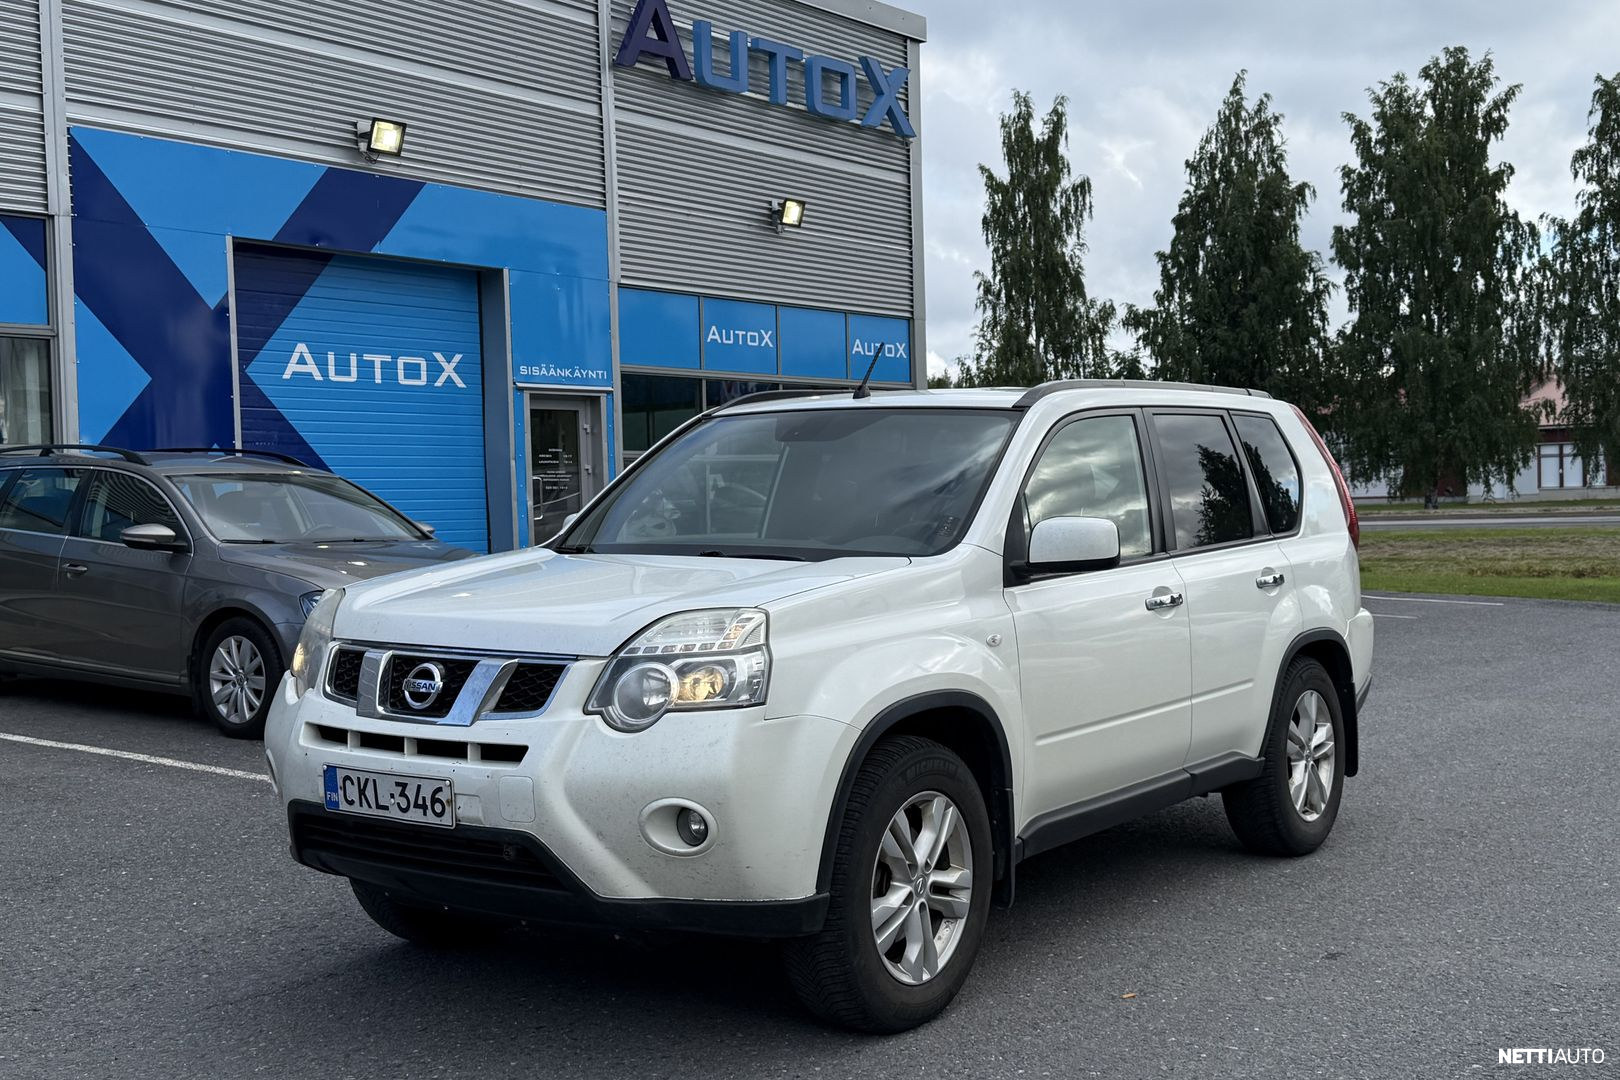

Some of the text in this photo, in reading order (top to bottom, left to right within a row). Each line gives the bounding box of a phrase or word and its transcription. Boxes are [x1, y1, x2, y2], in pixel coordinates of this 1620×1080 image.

[519, 363, 607, 380] SISÄÄNKÄYNTI
[326, 791, 338, 802] FIN
[342, 774, 446, 818] CKL-346
